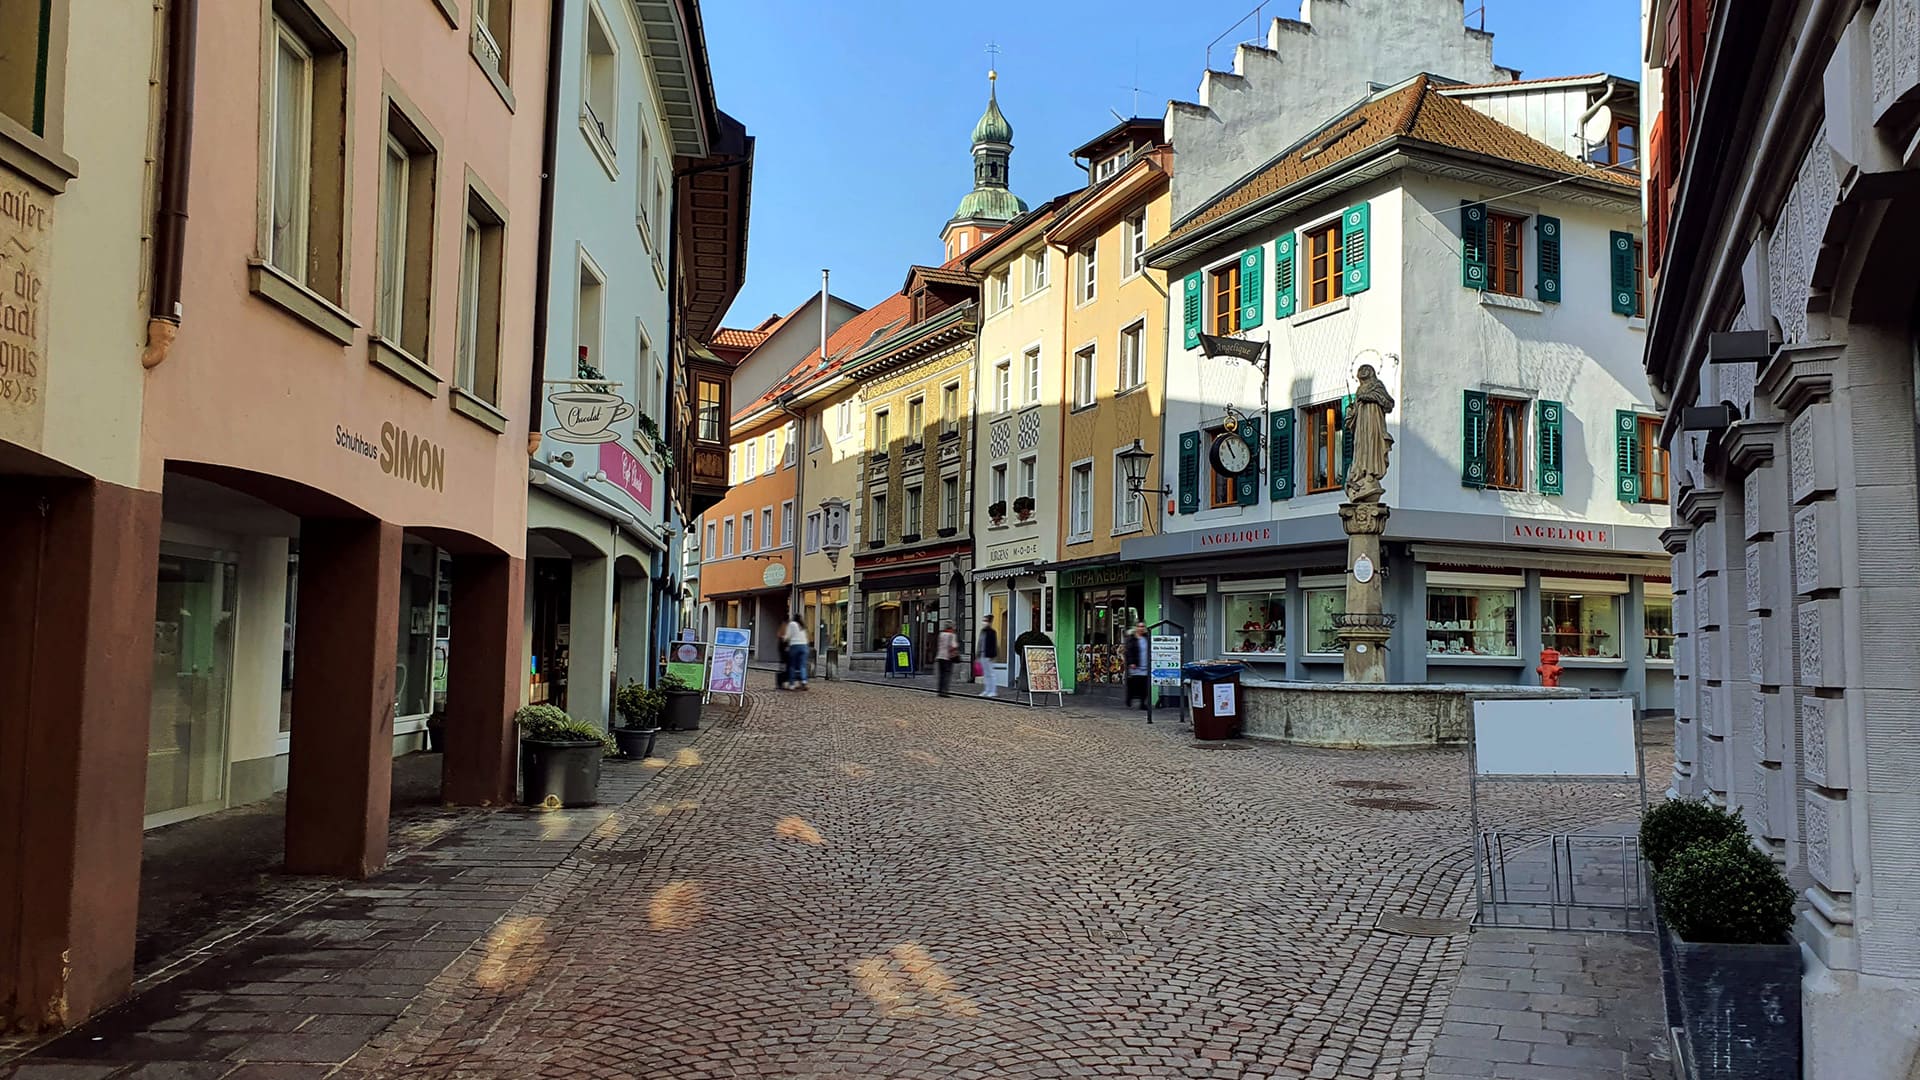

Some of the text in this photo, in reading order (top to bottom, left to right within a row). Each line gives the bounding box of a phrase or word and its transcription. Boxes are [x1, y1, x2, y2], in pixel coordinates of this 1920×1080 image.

[15, 262, 42, 303] die
[1215, 342, 1251, 356] Angelique
[568, 406, 603, 428] Chocolat
[336, 421, 445, 493] Schuhhaus SIMON
[1201, 528, 1270, 545] ANGELIQUE
[1513, 524, 1607, 543] ANGELIQUE
